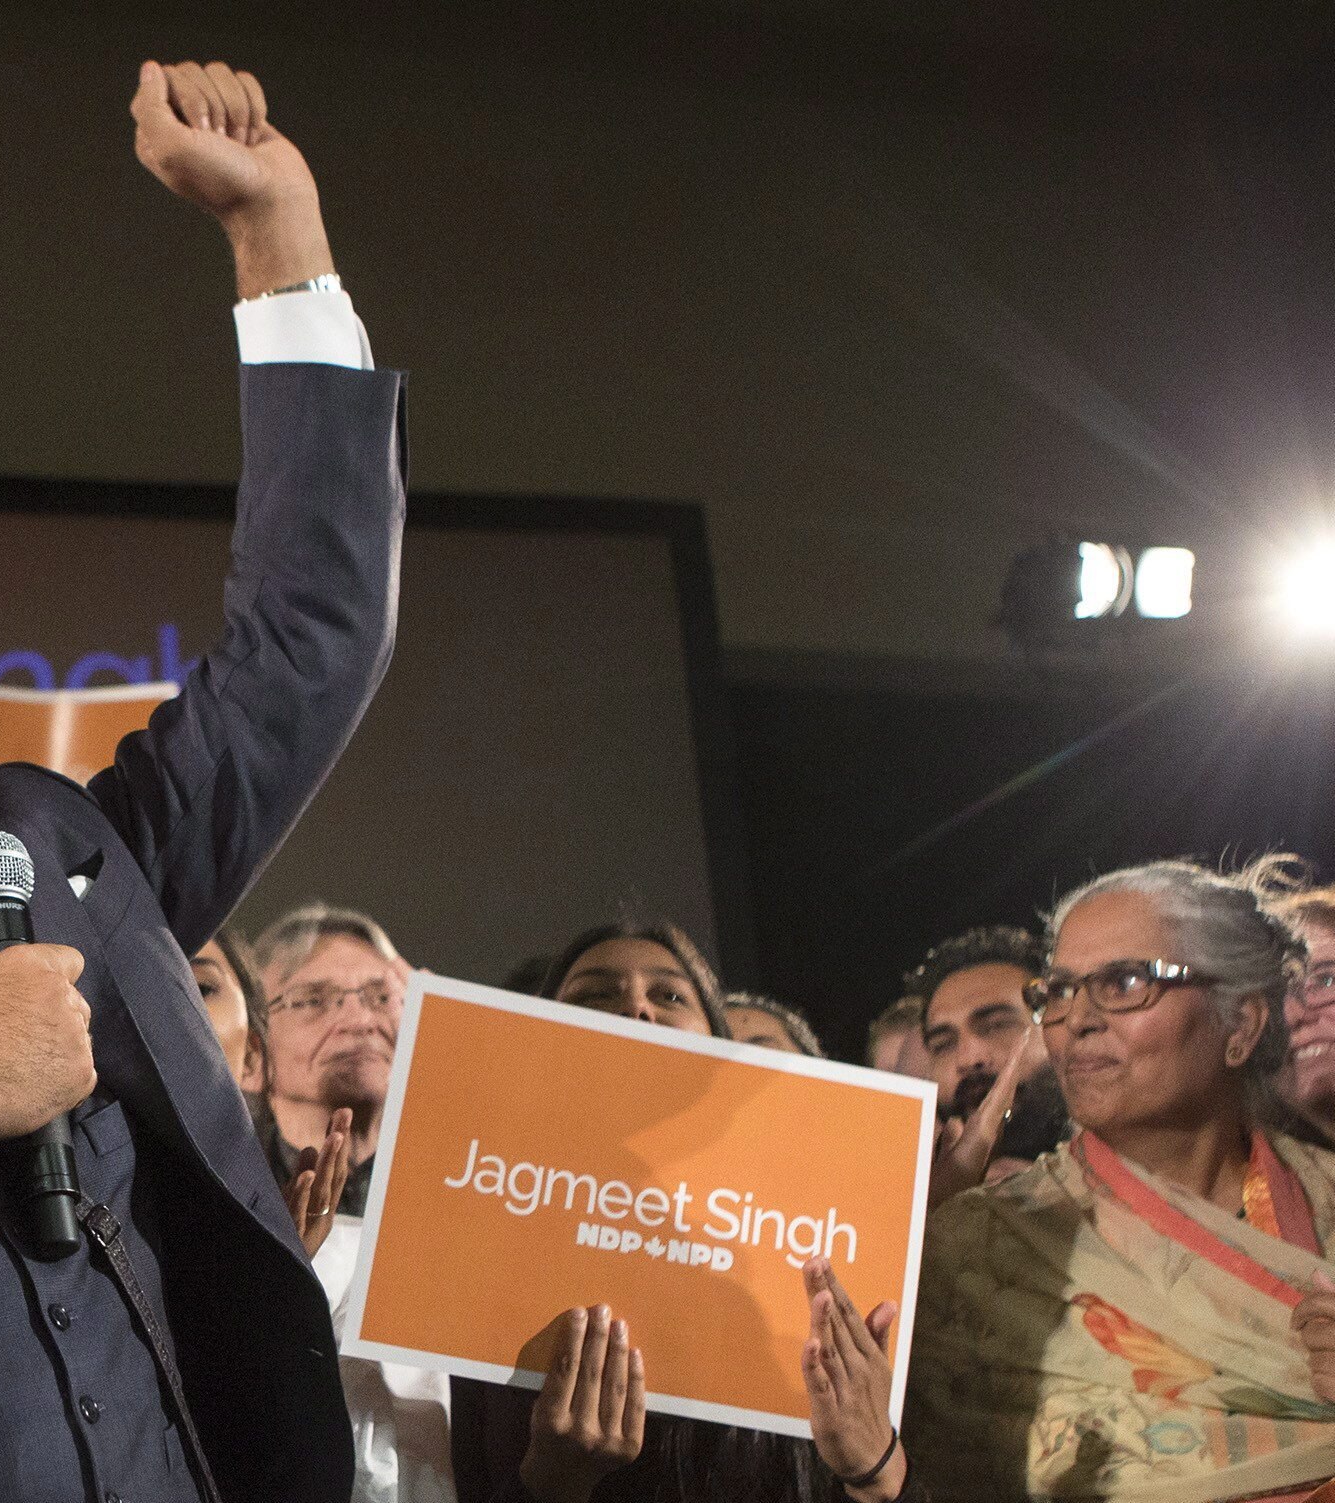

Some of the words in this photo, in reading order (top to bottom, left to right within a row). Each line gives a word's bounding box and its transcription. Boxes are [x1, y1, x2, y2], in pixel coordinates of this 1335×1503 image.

[444, 1138, 693, 1233] Jagmeet
[703, 1187, 857, 1269] Singh
[576, 1221, 643, 1254] NDP
[666, 1238, 734, 1272] NPD
